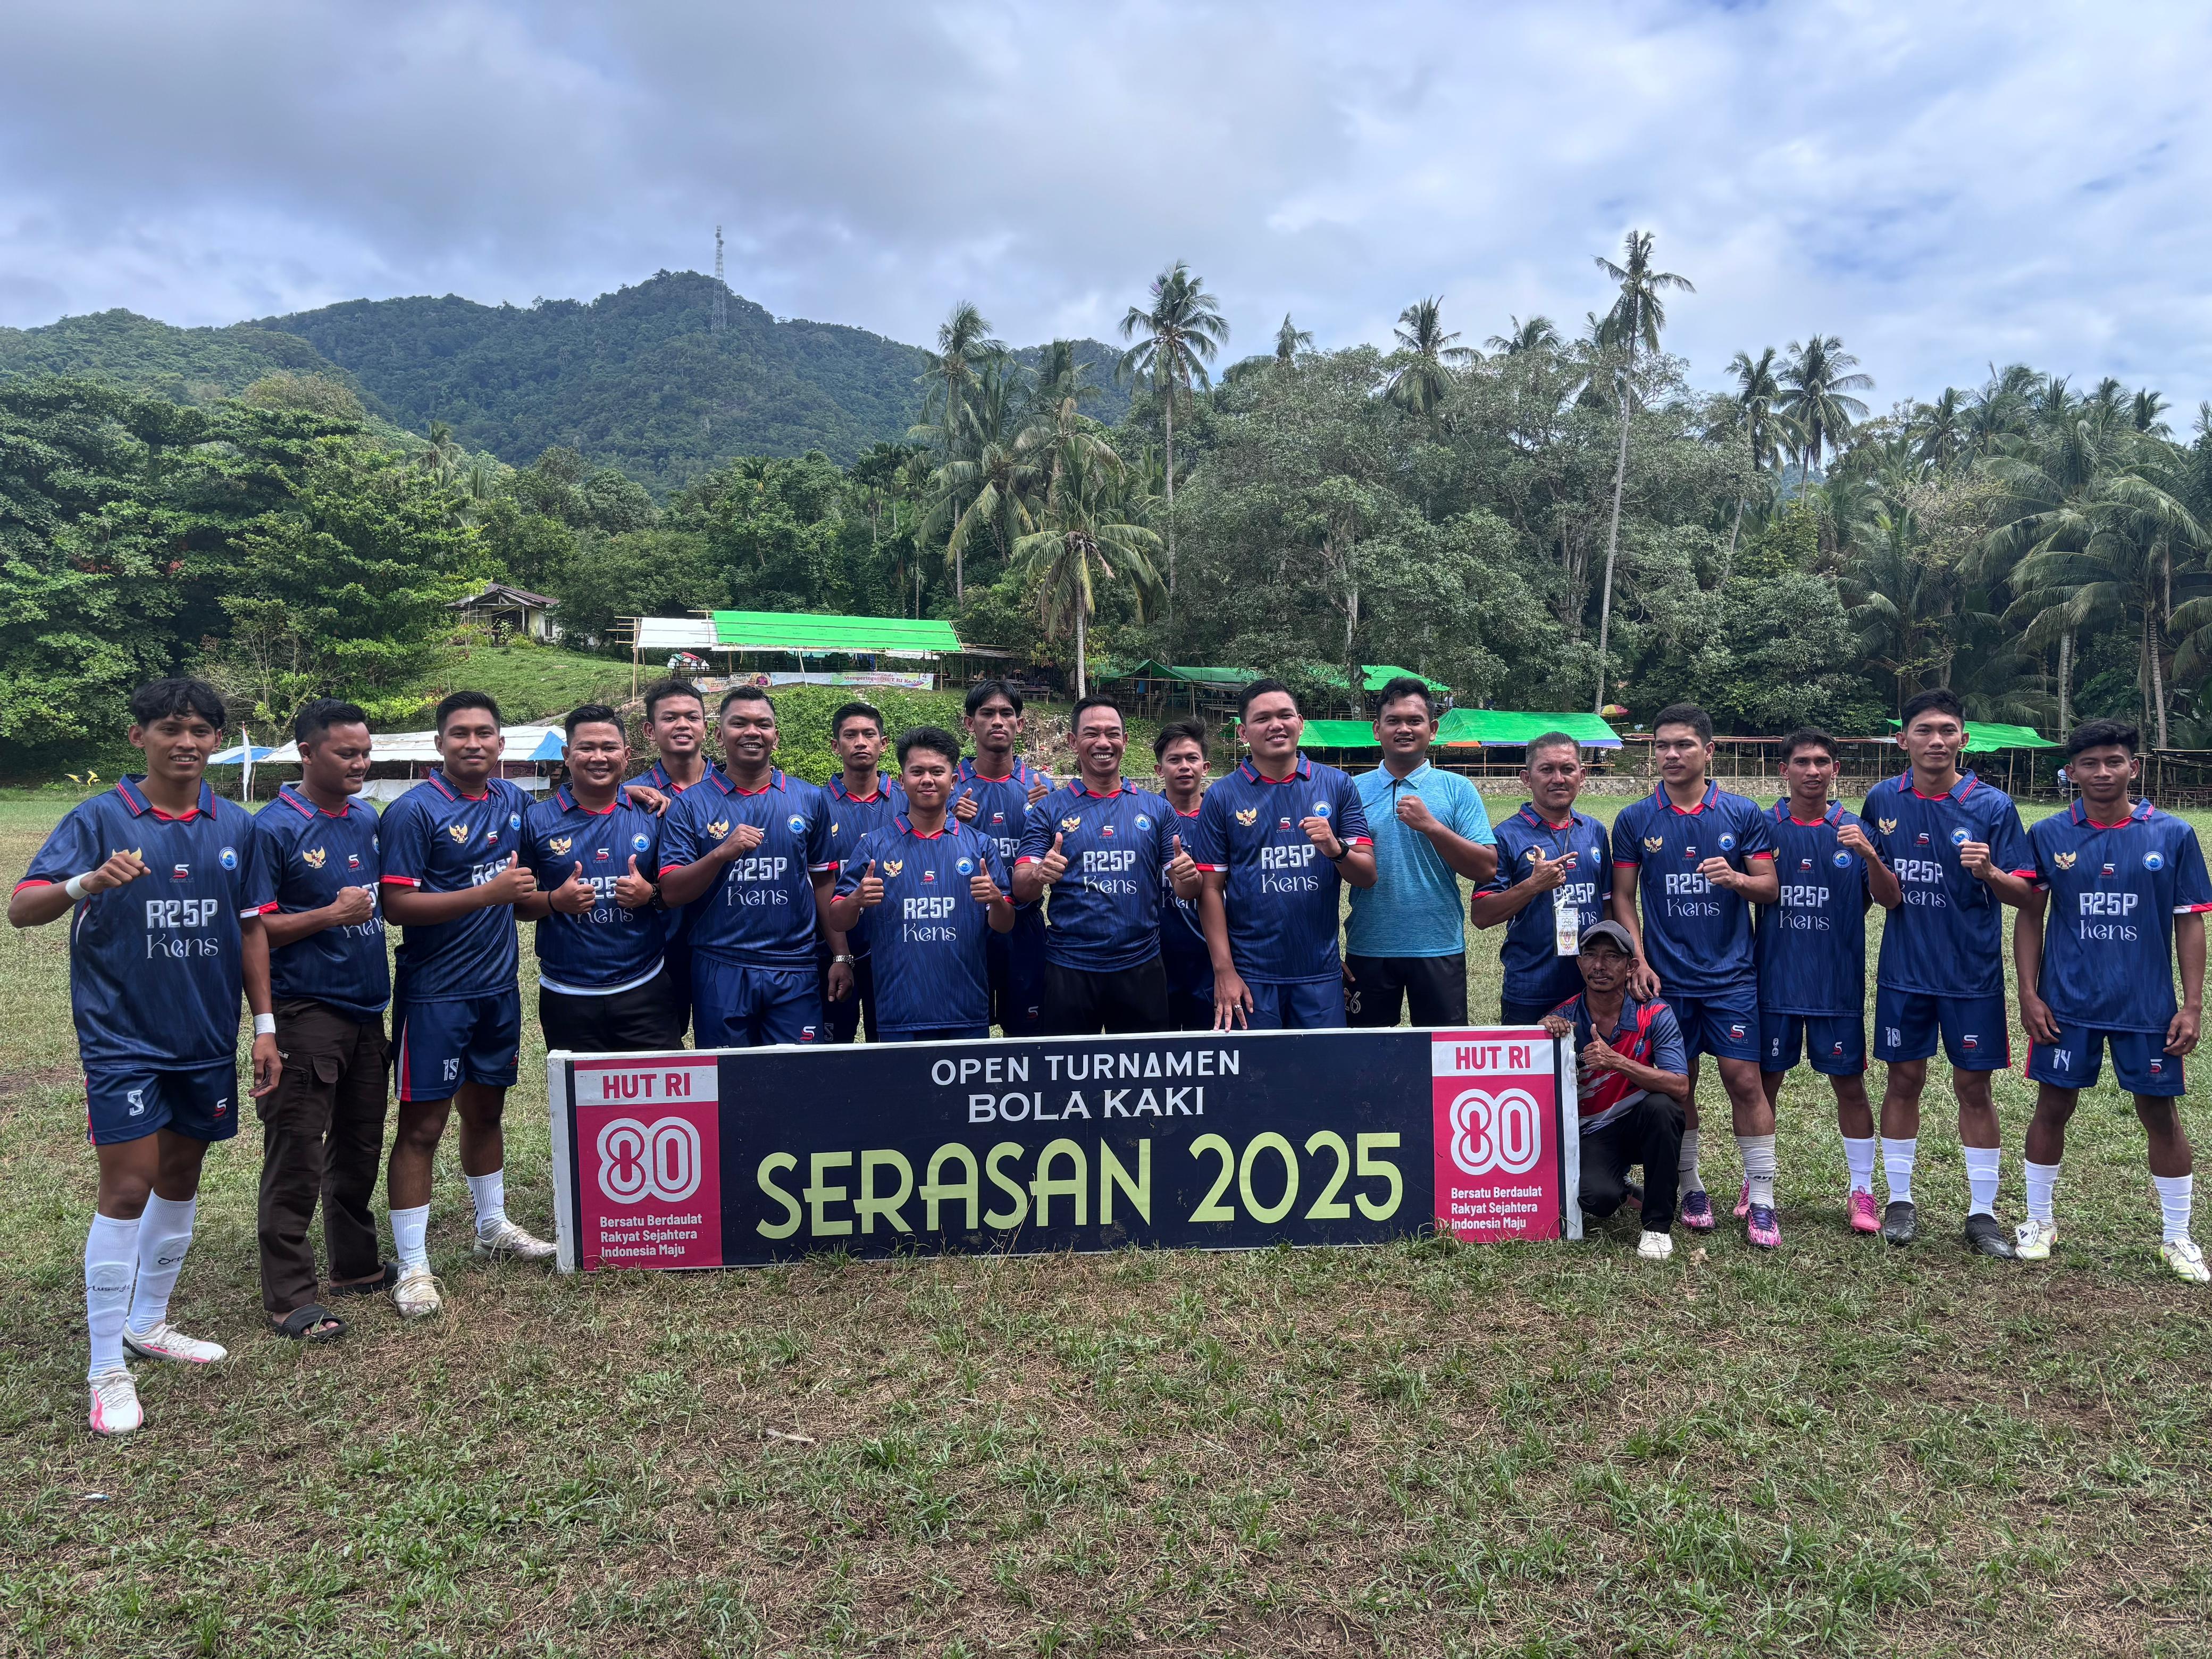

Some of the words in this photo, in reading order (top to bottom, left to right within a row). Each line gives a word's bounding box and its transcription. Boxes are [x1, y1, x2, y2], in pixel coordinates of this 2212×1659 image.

[1083, 850, 1136, 873] R25P
[1261, 844, 1315, 869] R25P
[472, 856, 513, 887] R25
[728, 857, 787, 882] R25P
[1084, 875, 1137, 894] Kens
[1261, 873, 1319, 894] Kens
[727, 885, 788, 906] Kens
[1780, 885, 1830, 908] R25P
[2079, 892, 2139, 916] R25P
[146, 899, 218, 929] R25P
[904, 897, 956, 920] R25P
[1666, 898, 1720, 917] Kens
[1779, 910, 1830, 931] Kens
[2080, 919, 2138, 941] Kens
[903, 923, 957, 943] Kens
[146, 933, 219, 959] Kens
[931, 1056, 1029, 1086] OPEN
[1044, 1050, 1239, 1081] TURNAMEN
[1455, 1046, 1502, 1070] HUT
[1509, 1045, 1531, 1069] RI
[2053, 1048, 2072, 1072] 14
[602, 1074, 657, 1099] HUT
[665, 1073, 691, 1097] RI
[968, 1091, 1092, 1123] BOLA
[1103, 1086, 1204, 1118] KAKI
[1449, 1088, 1541, 1176] 80
[597, 1117, 701, 1204] 80
[756, 1137, 1151, 1239] SERASAN
[1188, 1130, 1404, 1224] 2025
[1451, 1187, 1491, 1199] Bersatu
[1493, 1185, 1542, 1198] Berdaulat
[600, 1216, 644, 1227] Bersatu
[647, 1213, 702, 1226] Berdaulat
[1451, 1202, 1487, 1217] Rakyat
[1489, 1201, 1538, 1216] Sejahtera
[1451, 1217, 1501, 1230] Indonesia
[1503, 1216, 1526, 1231] Maju
[600, 1231, 640, 1245] Rakyat
[642, 1229, 698, 1243] Sejahtera
[601, 1244, 657, 1258] Indonesia
[659, 1243, 685, 1258] Maju
